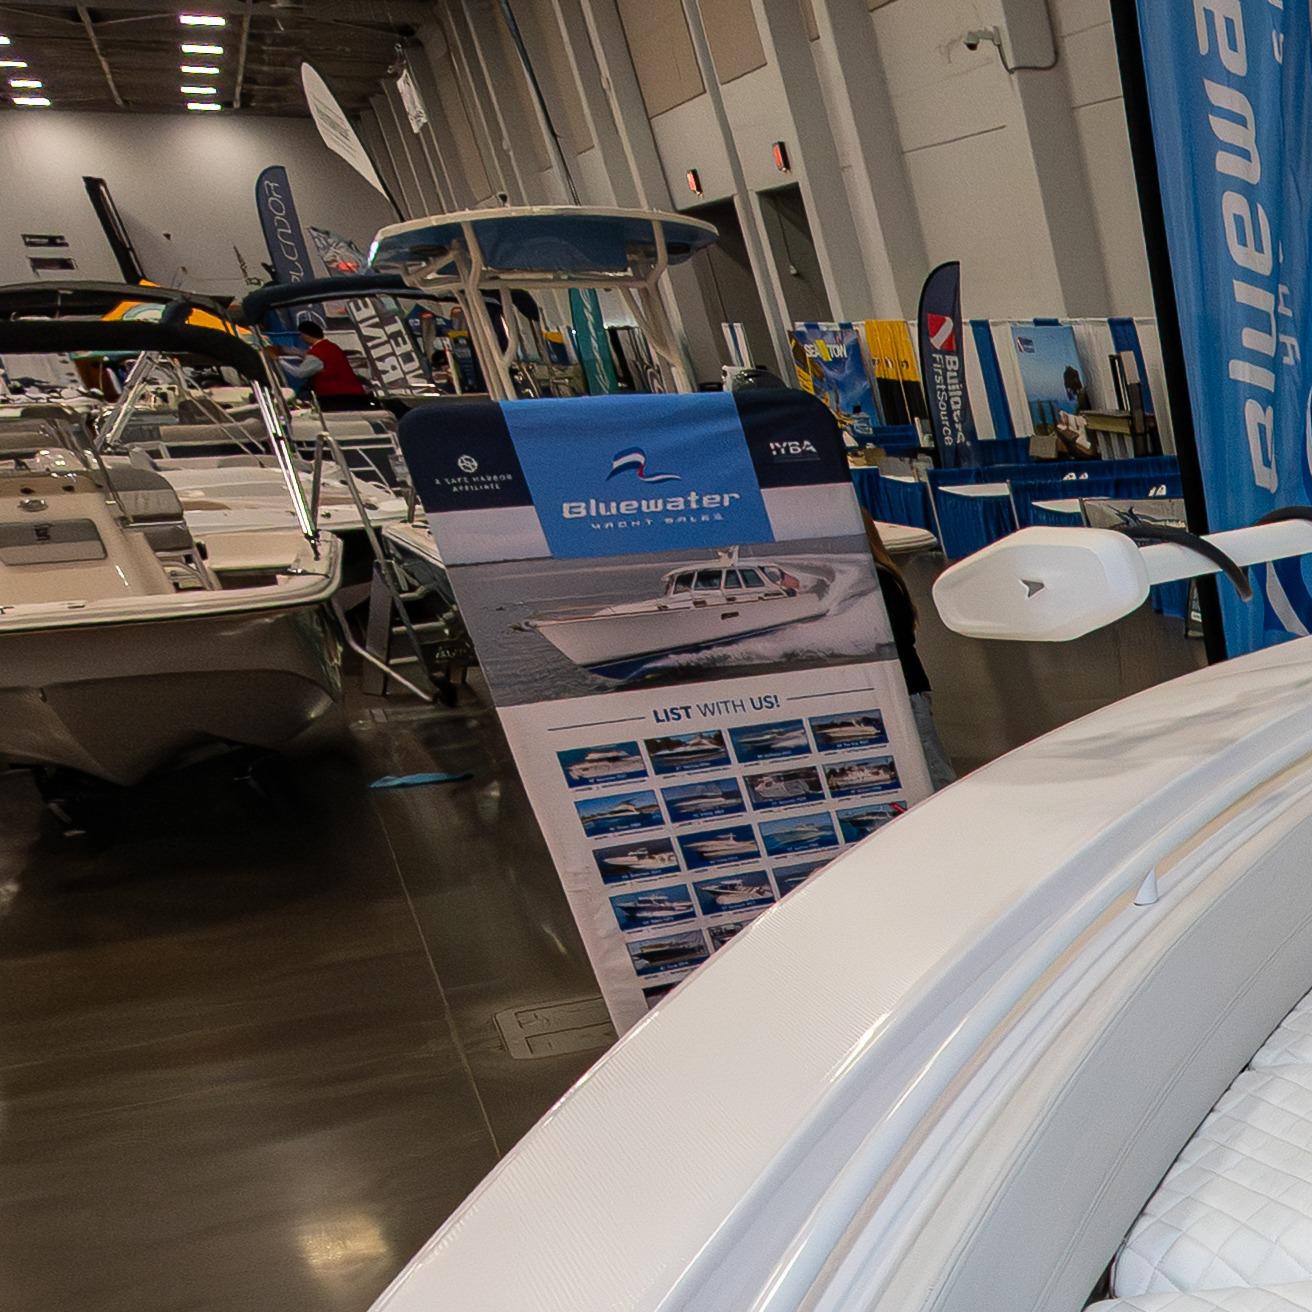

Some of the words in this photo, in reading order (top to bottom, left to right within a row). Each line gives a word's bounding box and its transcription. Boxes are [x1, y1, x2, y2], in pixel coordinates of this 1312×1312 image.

[932, 353, 953, 446] FirstSource
[562, 490, 740, 519] Bluewater
[664, 514, 724, 525] SALES
[653, 706, 692, 724] LIST
[696, 699, 746, 718] WITH
[749, 694, 781, 711] US!
